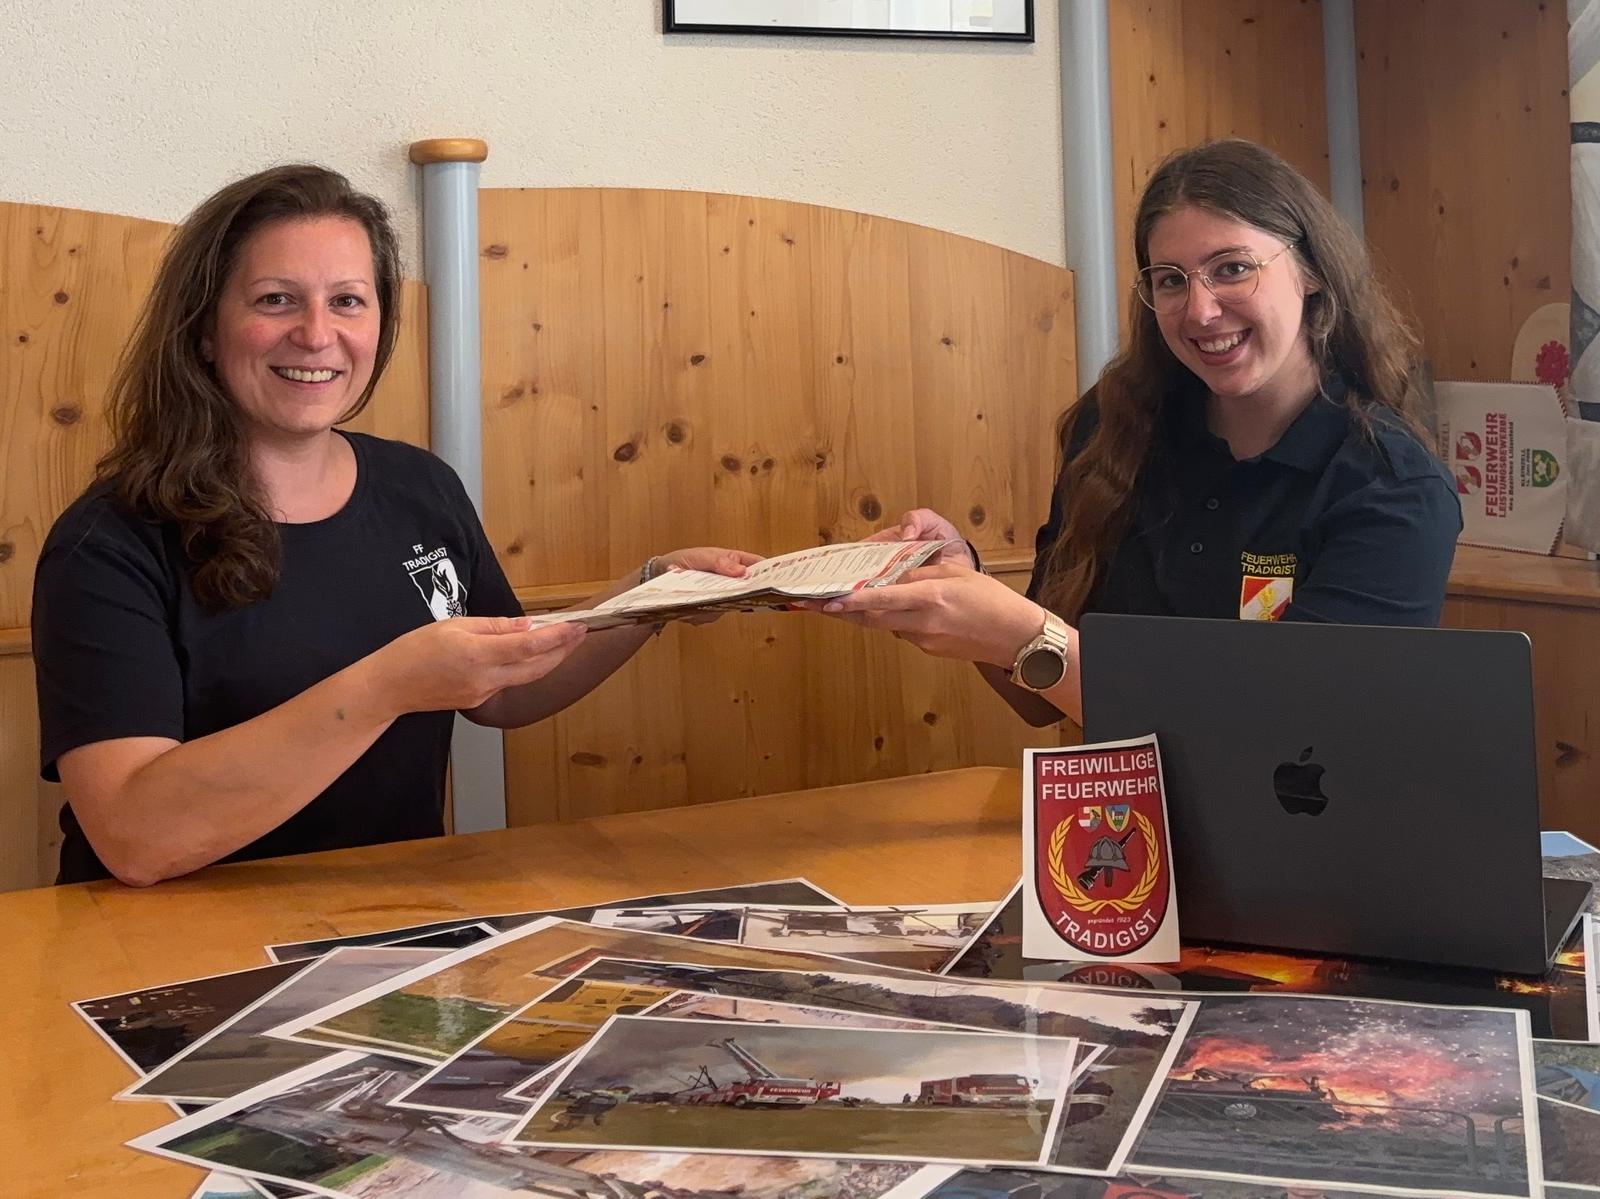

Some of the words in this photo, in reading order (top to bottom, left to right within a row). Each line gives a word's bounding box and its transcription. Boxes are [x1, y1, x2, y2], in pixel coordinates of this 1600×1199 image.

[1440, 423, 1449, 461] INZELL
[1486, 412, 1498, 517] FEUERWEHR
[1499, 413, 1507, 518] LEISTUNGSBEWERBE
[402, 547, 448, 571] TRADIGIST
[412, 544, 424, 554] FF
[1241, 551, 1297, 565] FEUERWEHR
[1241, 562, 1296, 575] TRADIGIST
[1041, 751, 1155, 777] FREIWILLIGE
[1042, 776, 1158, 800] FEUERWEHR
[1055, 908, 1158, 949] TRADIGIST
